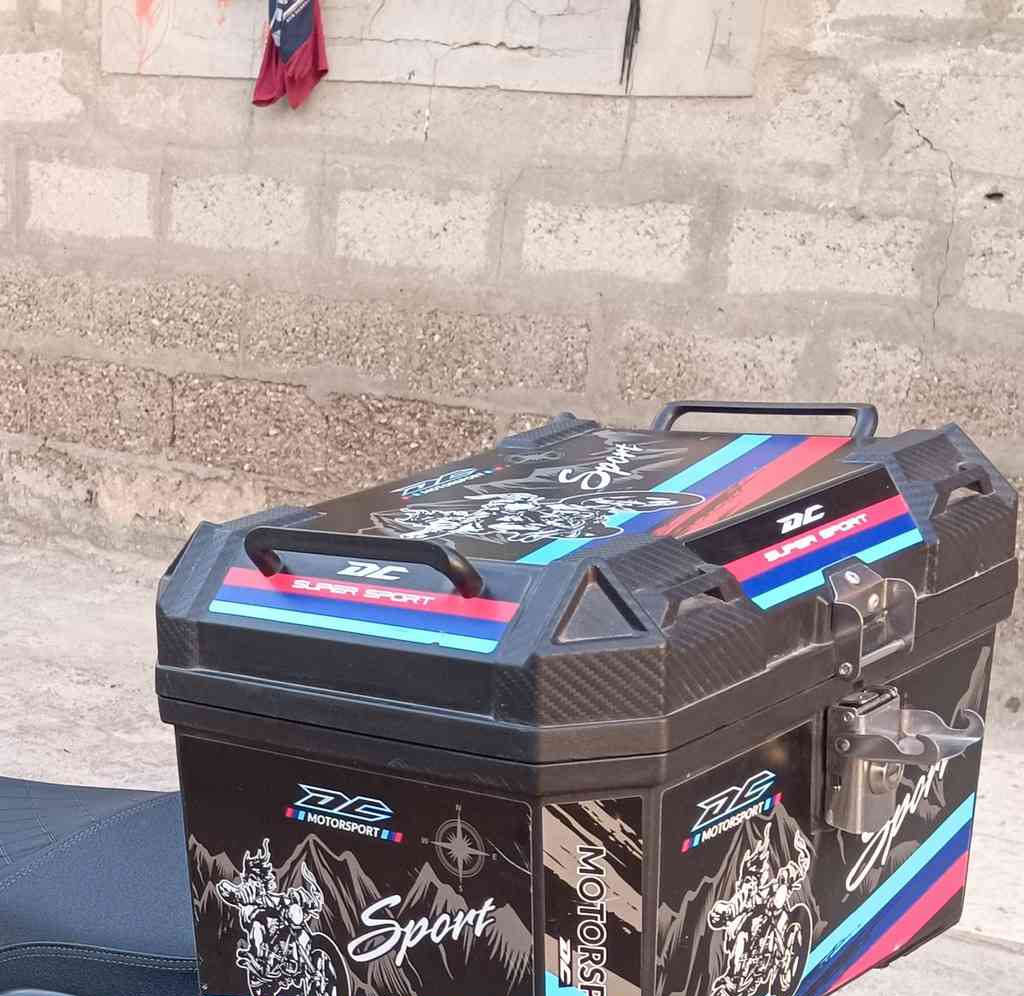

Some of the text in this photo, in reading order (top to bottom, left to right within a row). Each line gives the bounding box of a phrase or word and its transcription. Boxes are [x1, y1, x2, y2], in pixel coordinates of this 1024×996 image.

[762, 513, 869, 562] SUPER SPORT
[291, 578, 437, 606] SUPER SPORT
[306, 811, 381, 839] MOTORSPORT
[701, 800, 765, 843] MOTORSPORT
[347, 894, 496, 967] Sport
